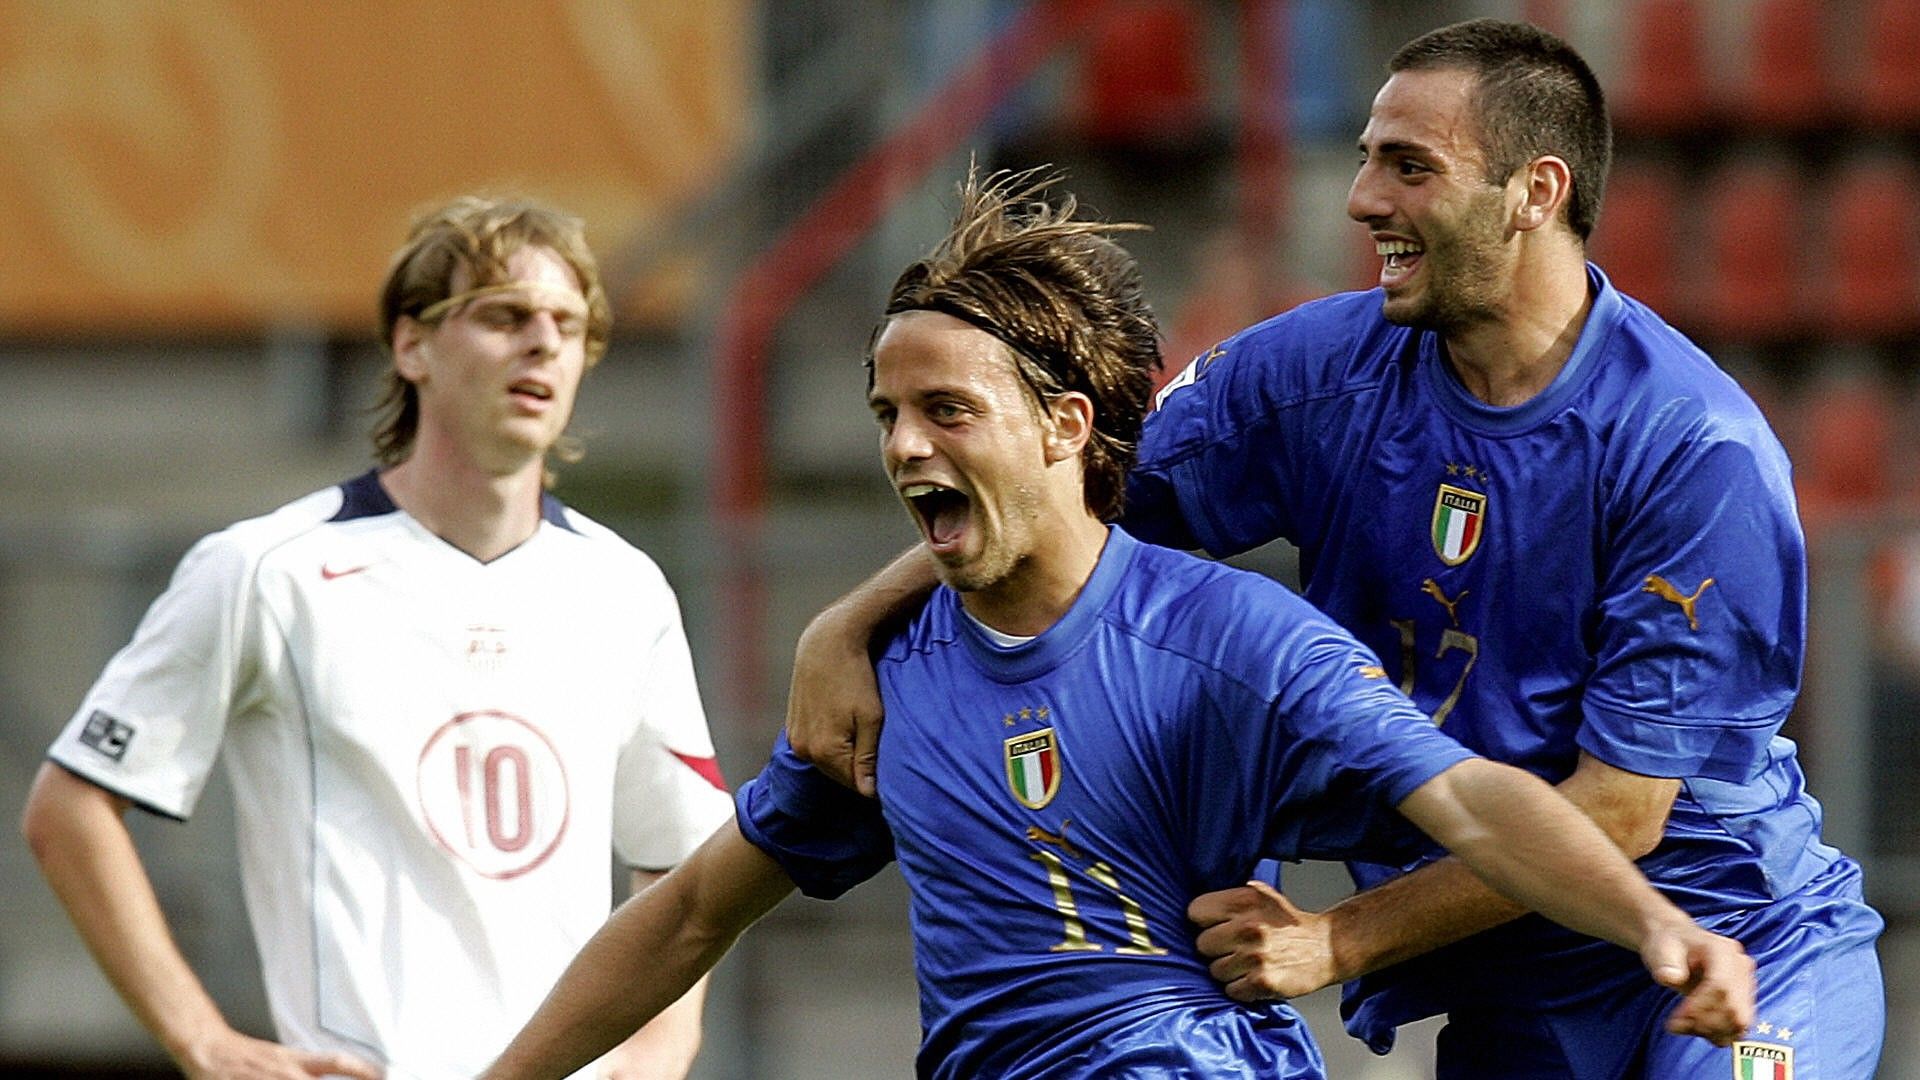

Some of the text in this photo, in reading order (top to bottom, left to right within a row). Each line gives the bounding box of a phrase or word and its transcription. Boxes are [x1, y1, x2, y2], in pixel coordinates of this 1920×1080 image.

[1444, 494, 1478, 512] ITALIA
[1389, 619, 1478, 728] 17
[1012, 737, 1049, 755] ITALIA
[455, 745, 534, 852] 10
[1030, 850, 1169, 956] 11
[1742, 1046, 1785, 1061] ITALIA
